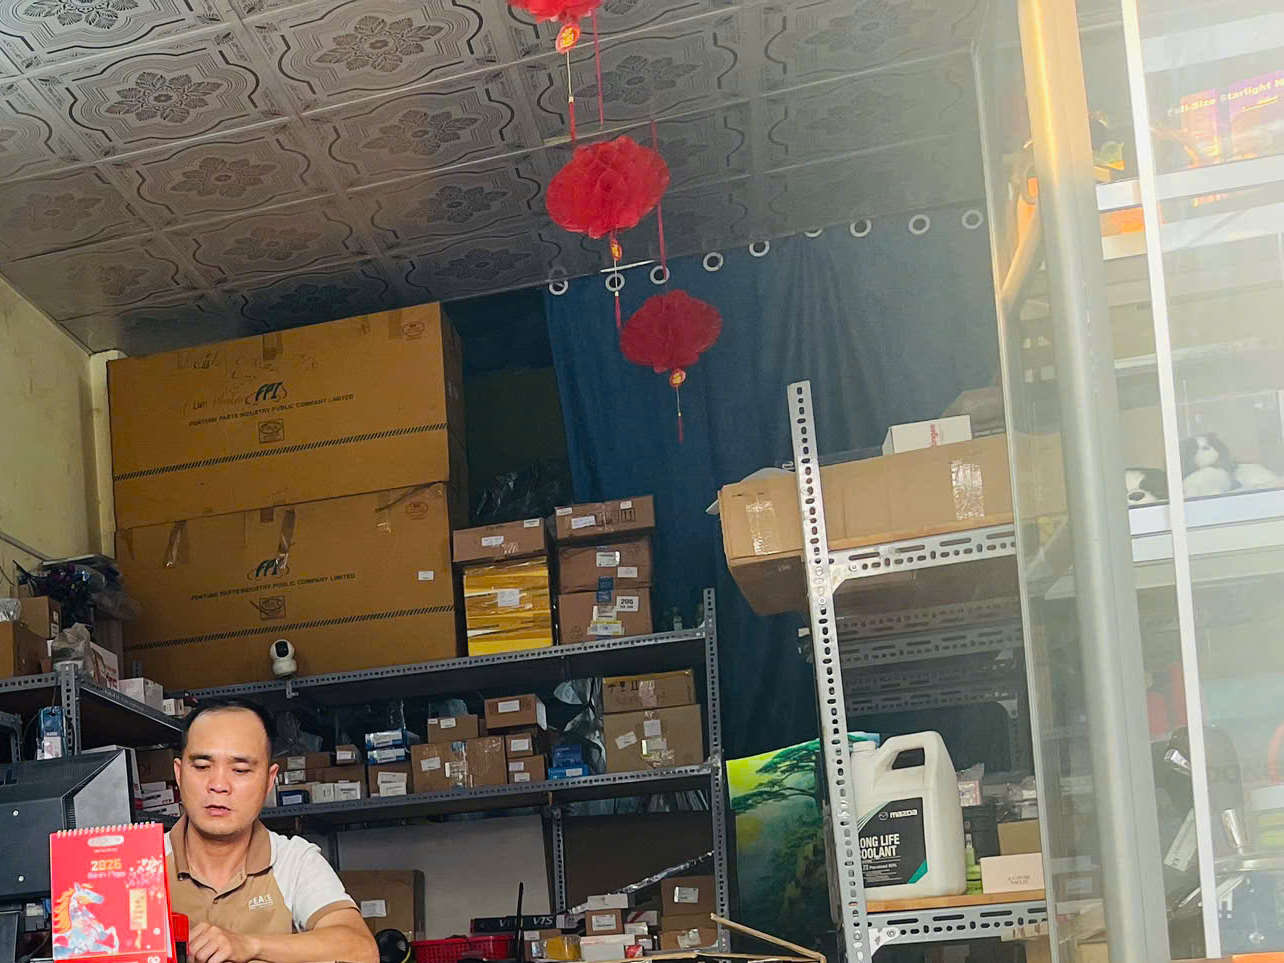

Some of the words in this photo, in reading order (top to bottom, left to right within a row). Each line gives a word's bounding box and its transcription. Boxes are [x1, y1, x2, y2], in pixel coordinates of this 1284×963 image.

[1219, 81, 1272, 102] Starlight
[219, 413, 239, 422] PARTS
[240, 407, 271, 418] INDUSTRY
[272, 403, 295, 413] PUBLIC
[296, 398, 327, 408] COMPANY
[328, 393, 354, 403] LIMITED
[240, 584, 271, 594] INDUSTRY
[273, 580, 296, 589] PUBLIC
[297, 576, 329, 586] COMPANY
[330, 572, 356, 582] LIMITED
[889, 809, 918, 819] mazda
[859, 835, 879, 848] ONG
[880, 833, 901, 846] LIFE
[861, 845, 897, 859] OOLANT
[91, 858, 122, 872] 2026
